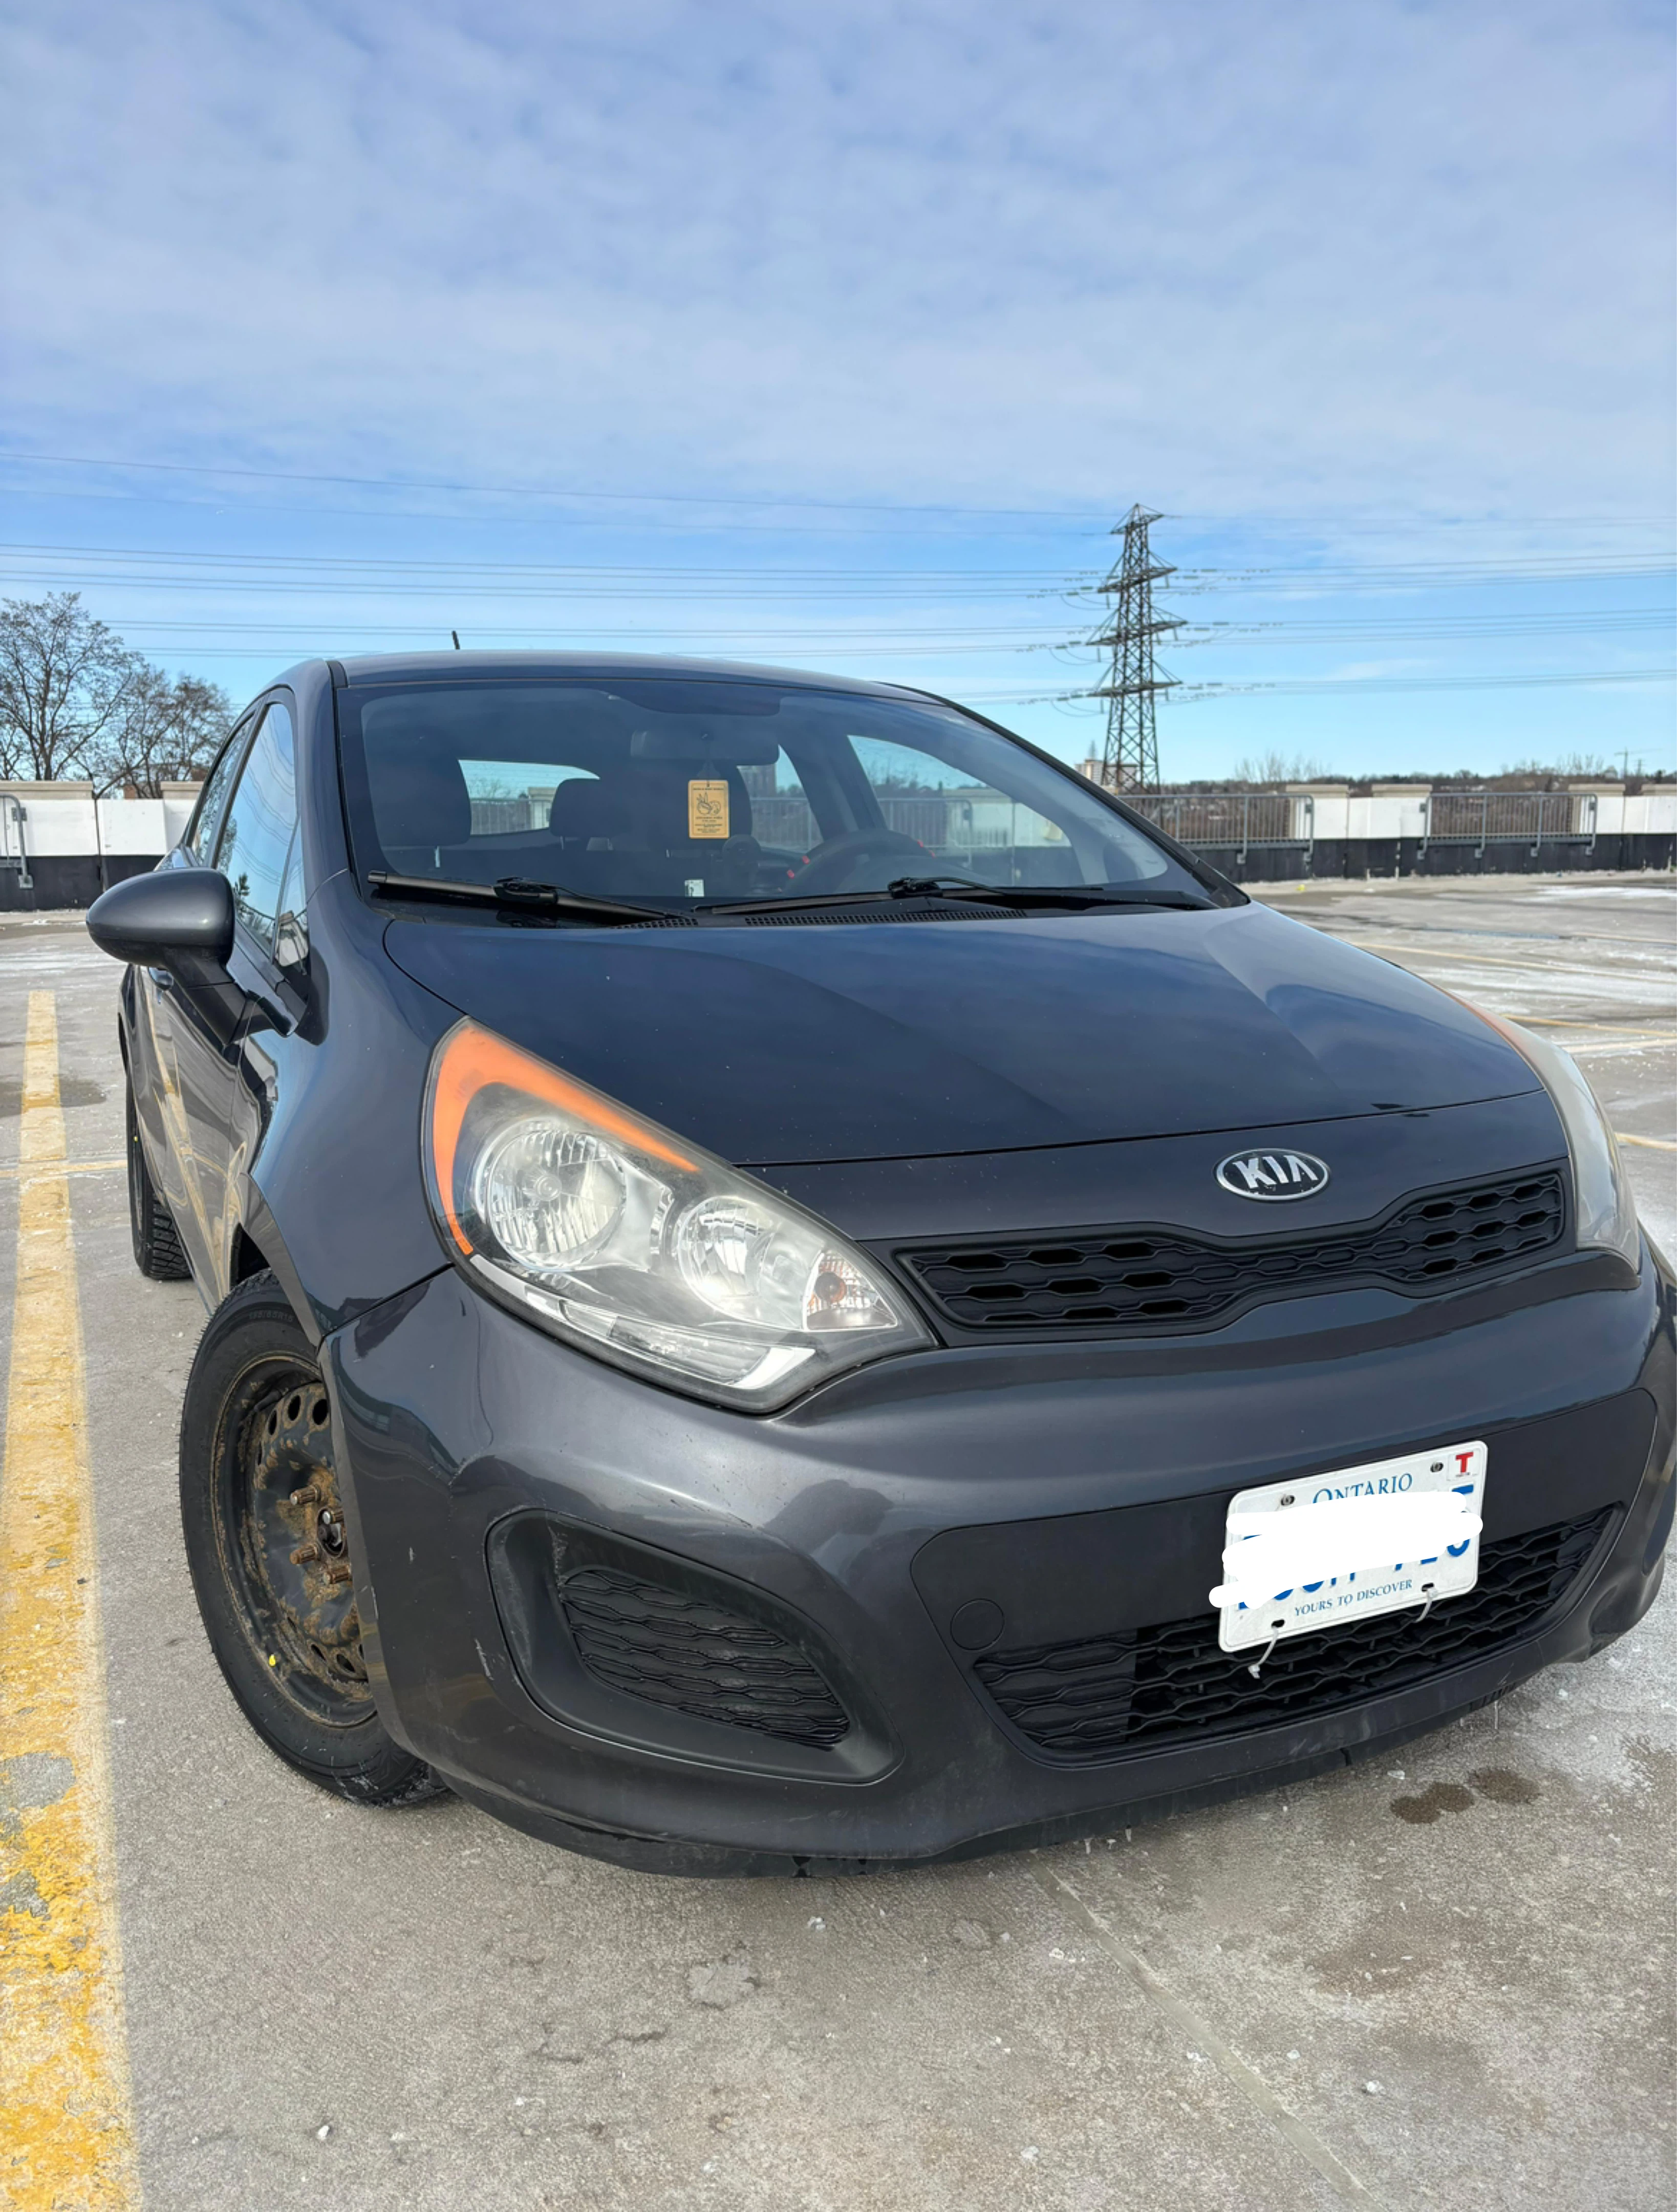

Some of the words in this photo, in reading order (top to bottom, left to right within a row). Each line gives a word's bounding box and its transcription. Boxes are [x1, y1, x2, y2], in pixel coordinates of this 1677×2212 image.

[1232, 1155, 1318, 1189] KIA
[1455, 1452, 1474, 1473] T
[1313, 1473, 1412, 1504] ONTARIO
[1295, 1599, 1332, 1616] YOURS
[1338, 1593, 1353, 1606] TO
[1357, 1579, 1412, 1601] DISCOVER
